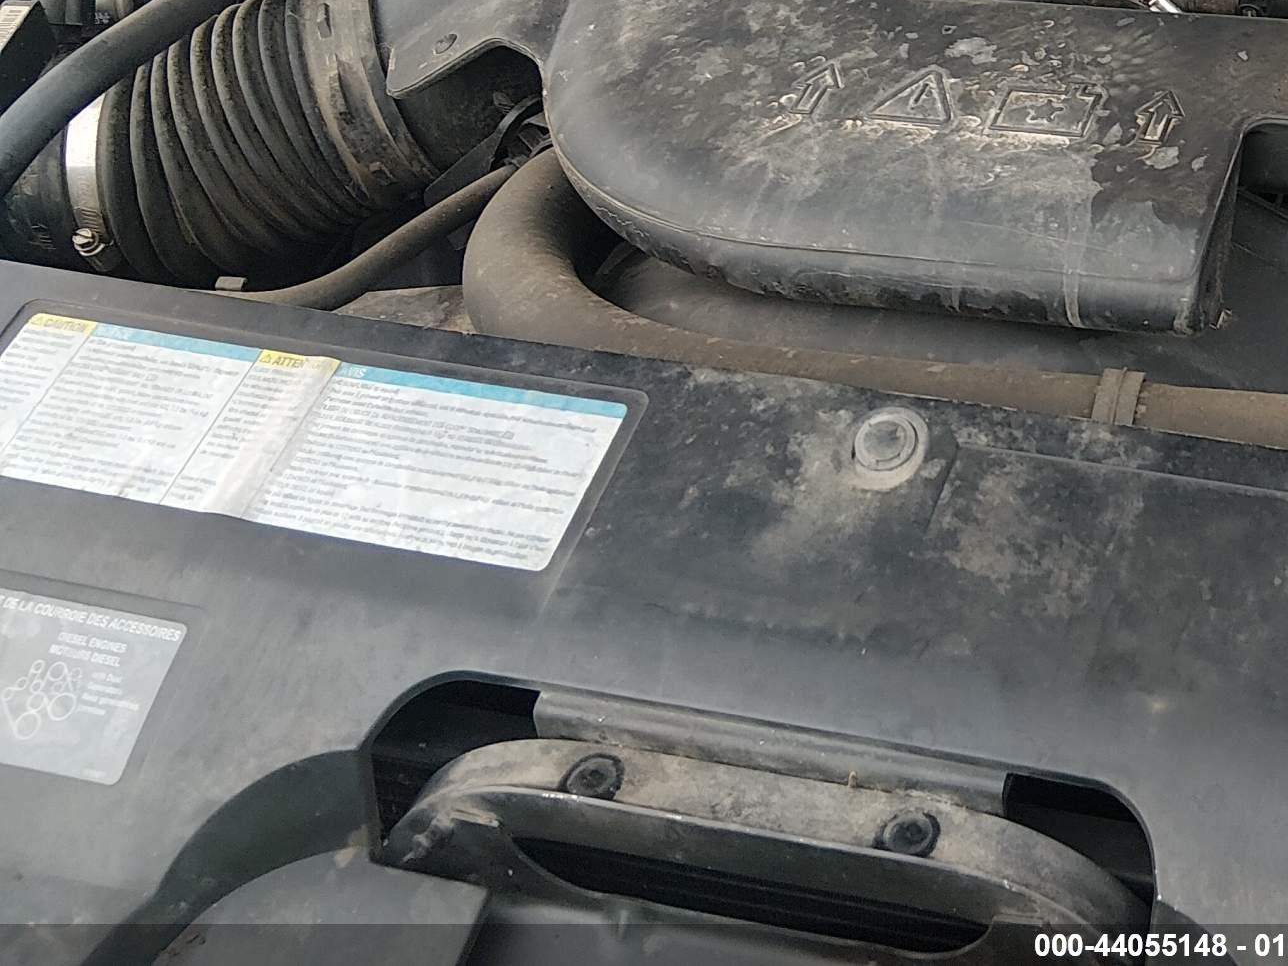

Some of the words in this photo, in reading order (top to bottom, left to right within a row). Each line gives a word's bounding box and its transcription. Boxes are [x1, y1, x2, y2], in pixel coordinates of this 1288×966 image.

[20, 600, 33, 612] LA
[87, 612, 109, 628] DES
[108, 618, 182, 642] ACCESSOIRES
